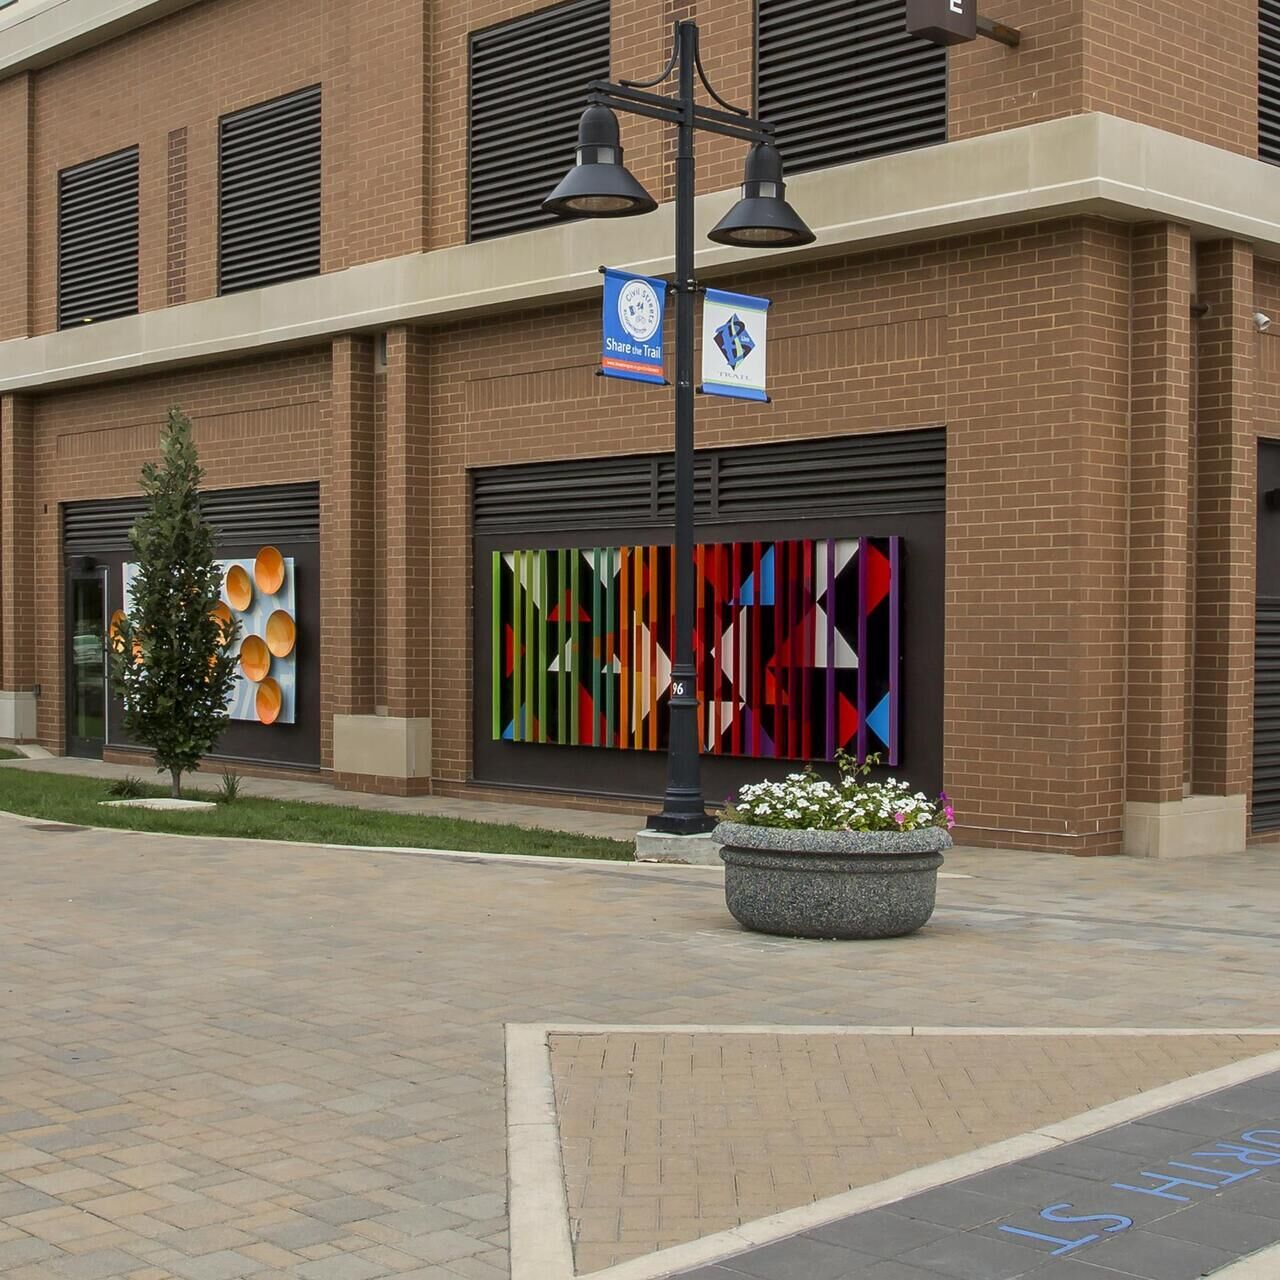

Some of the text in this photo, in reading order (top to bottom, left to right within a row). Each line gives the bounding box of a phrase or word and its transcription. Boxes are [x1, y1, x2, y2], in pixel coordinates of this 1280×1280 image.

[625, 287, 640, 302] Civil
[641, 290, 655, 324] Streets
[606, 337, 661, 359] Share the Trail
[672, 682, 684, 695] 96
[998, 1202, 1133, 1256] ST
